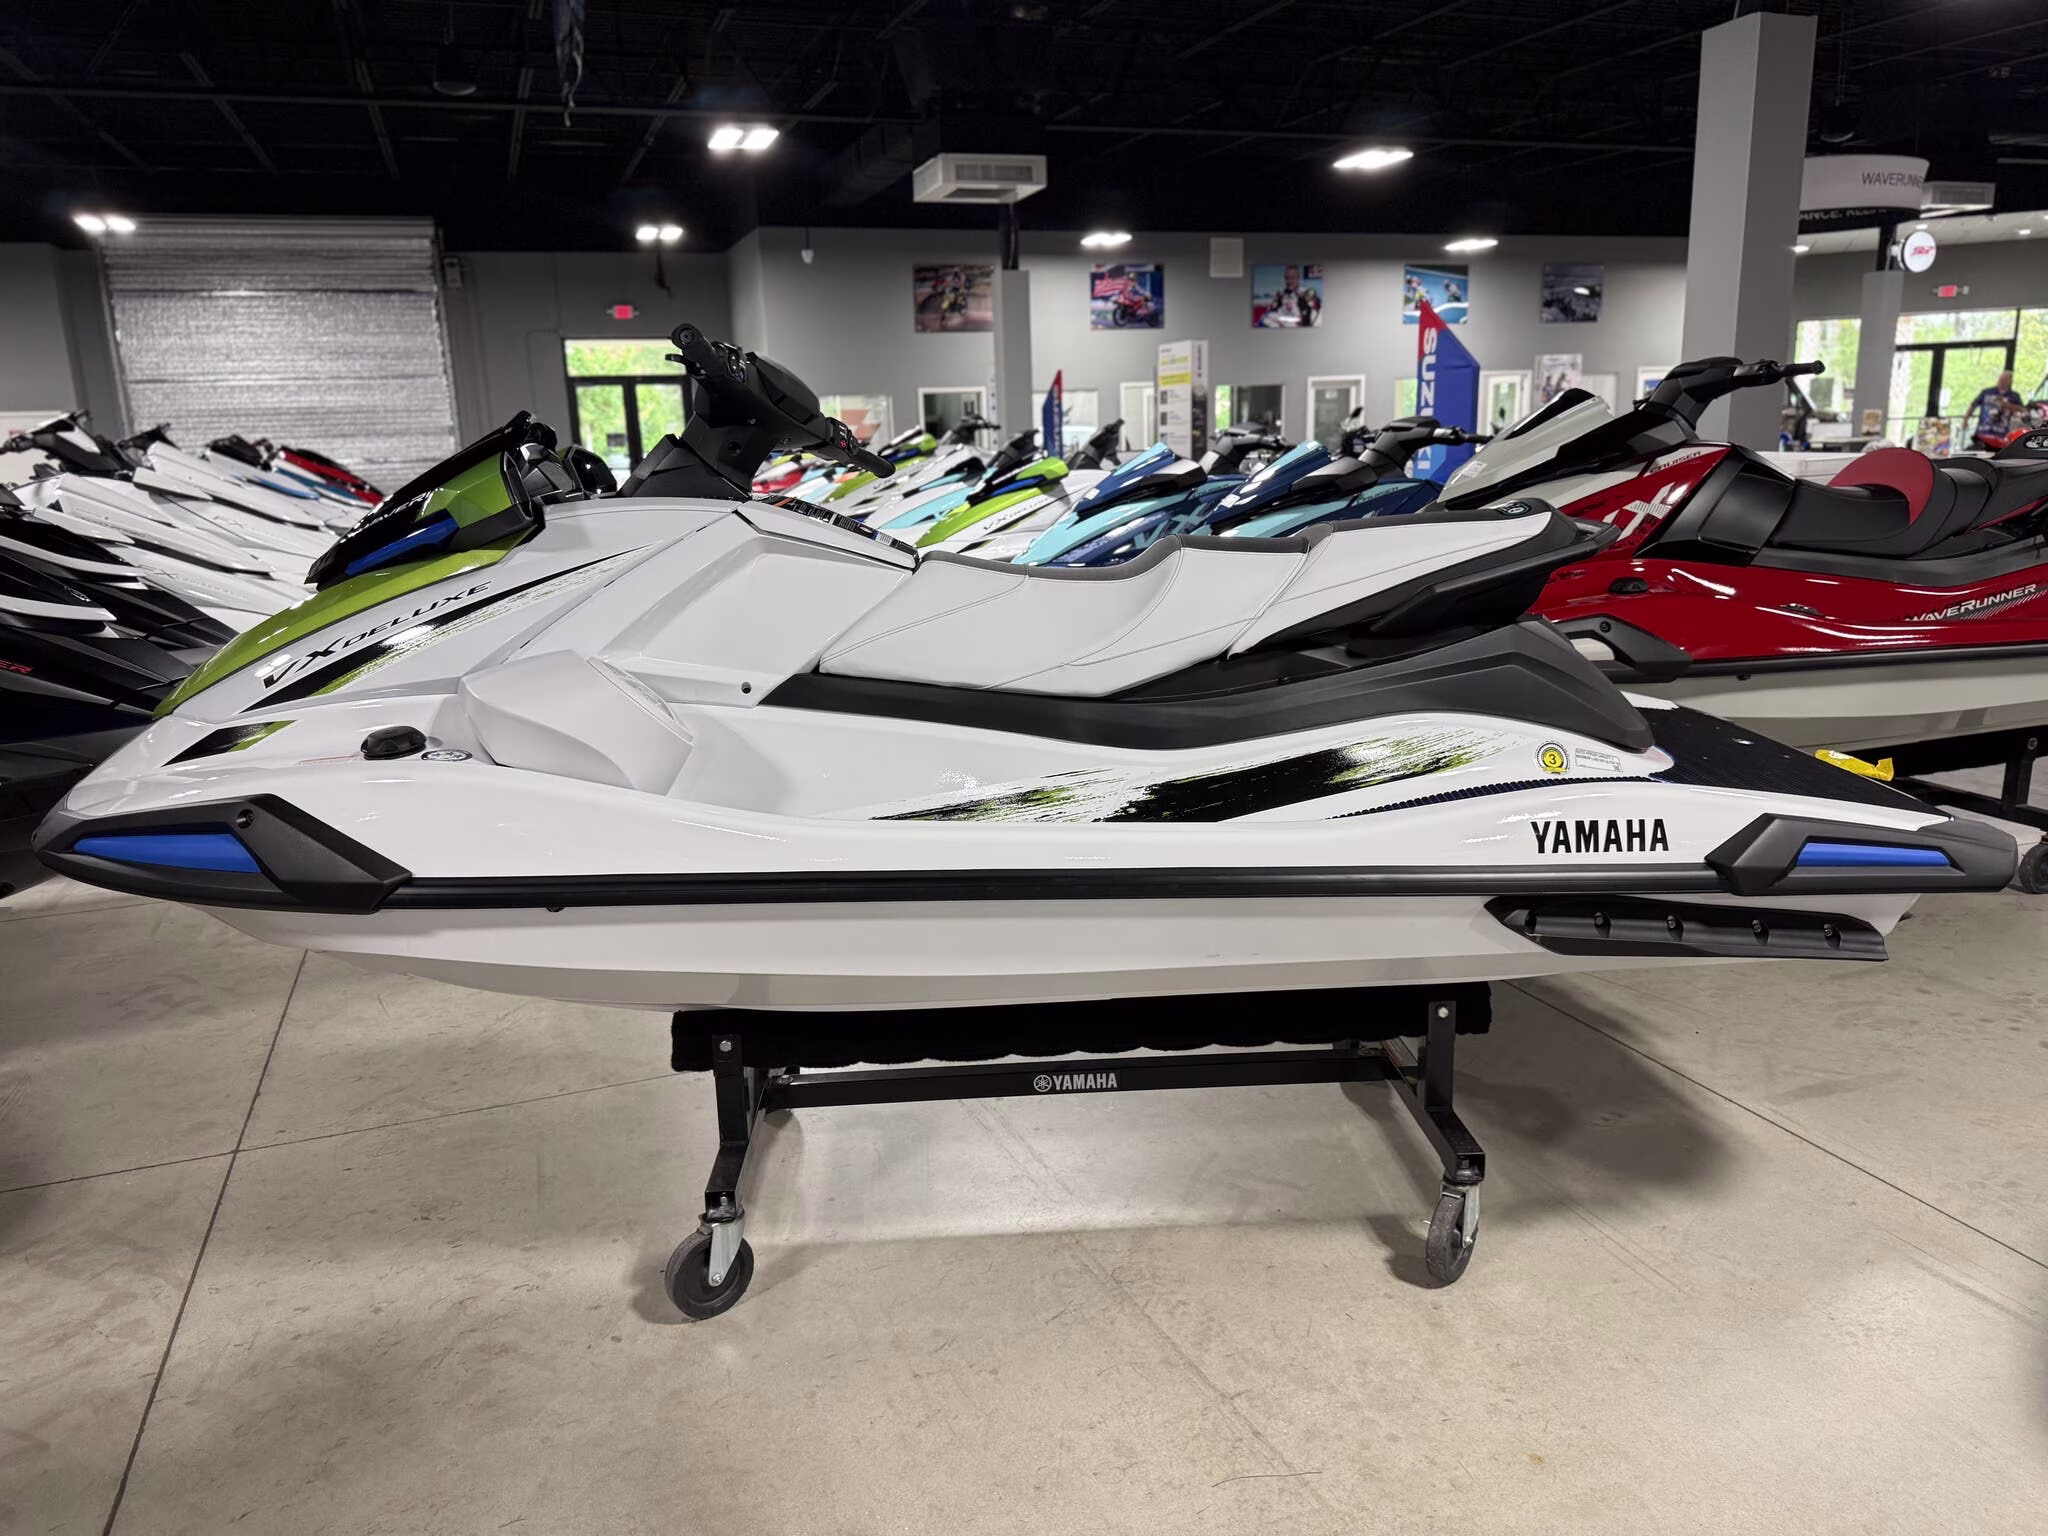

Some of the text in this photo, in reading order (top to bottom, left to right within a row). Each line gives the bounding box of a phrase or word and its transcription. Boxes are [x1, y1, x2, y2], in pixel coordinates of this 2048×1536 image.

[1417, 327, 1437, 470] SUZKI
[262, 580, 493, 689] VX DELUXE
[1548, 753, 1557, 765] 3
[1530, 818, 1670, 854] YAMAHA
[1052, 1072, 1118, 1091] YAMAHA
